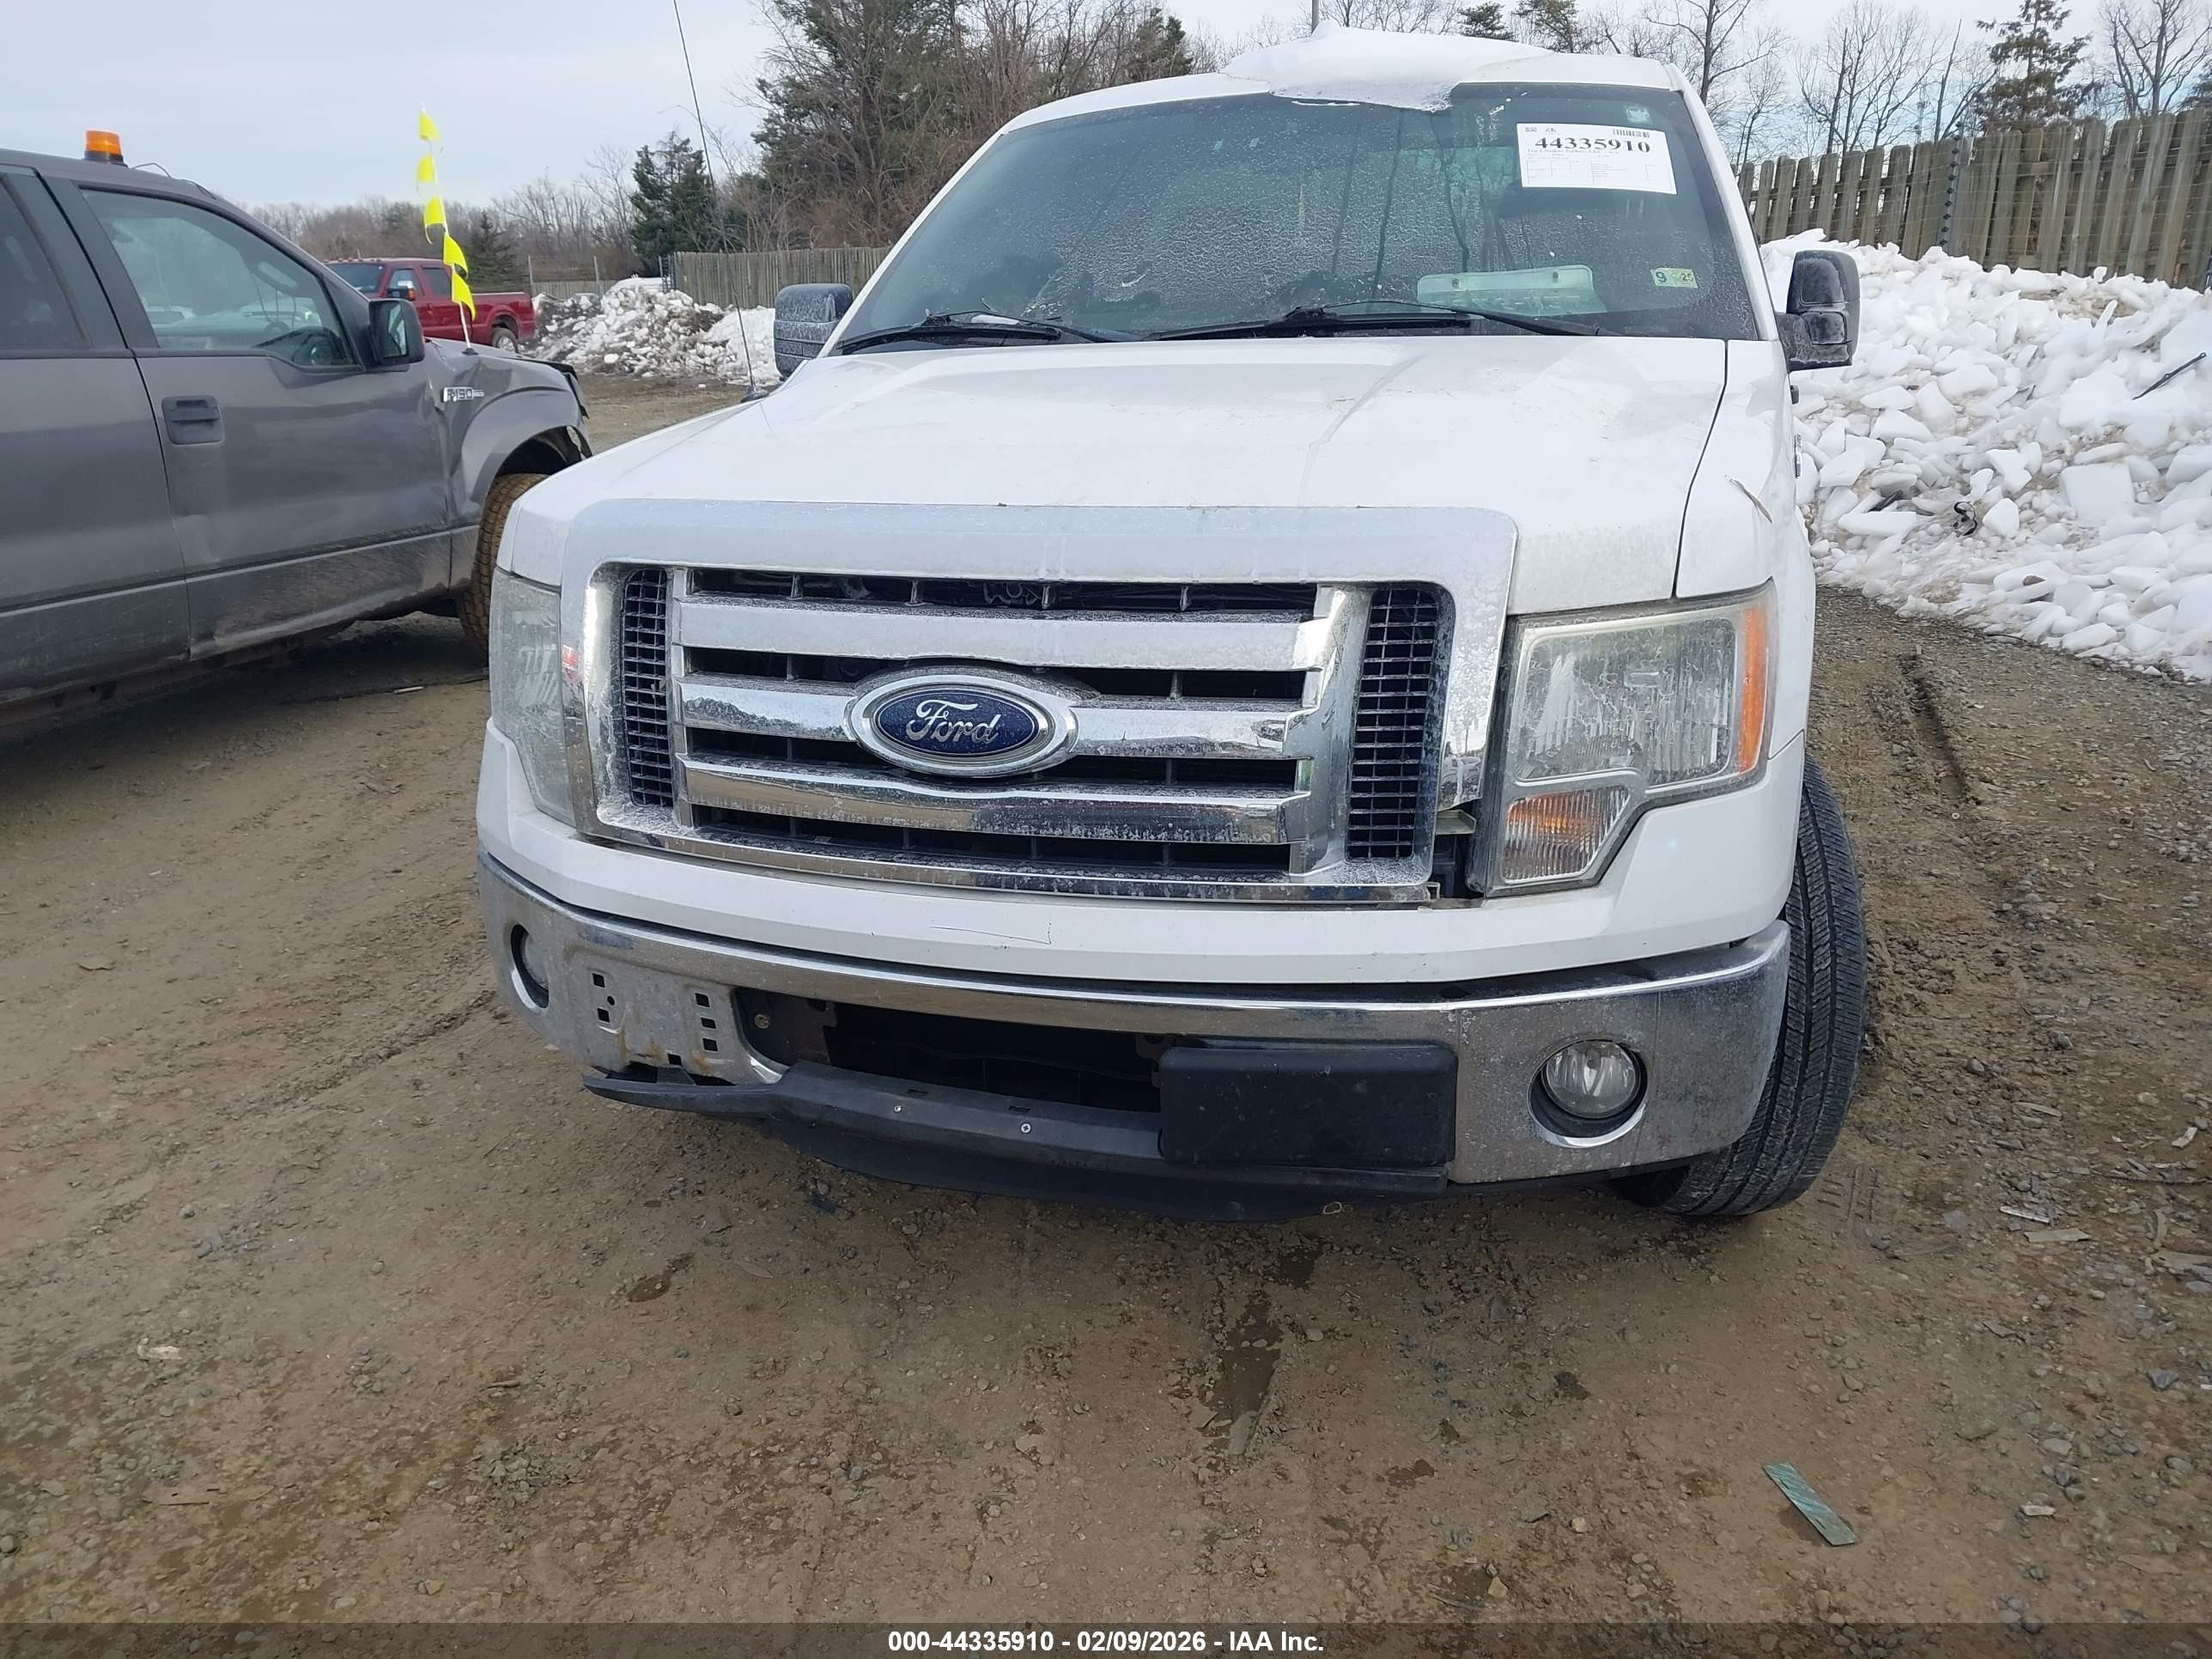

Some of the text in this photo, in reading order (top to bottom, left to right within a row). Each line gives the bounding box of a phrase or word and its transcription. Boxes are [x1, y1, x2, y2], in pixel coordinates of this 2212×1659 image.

[1535, 137, 1650, 152] 44335910
[1656, 271, 1667, 283] 9
[906, 699, 1001, 744] Ford
